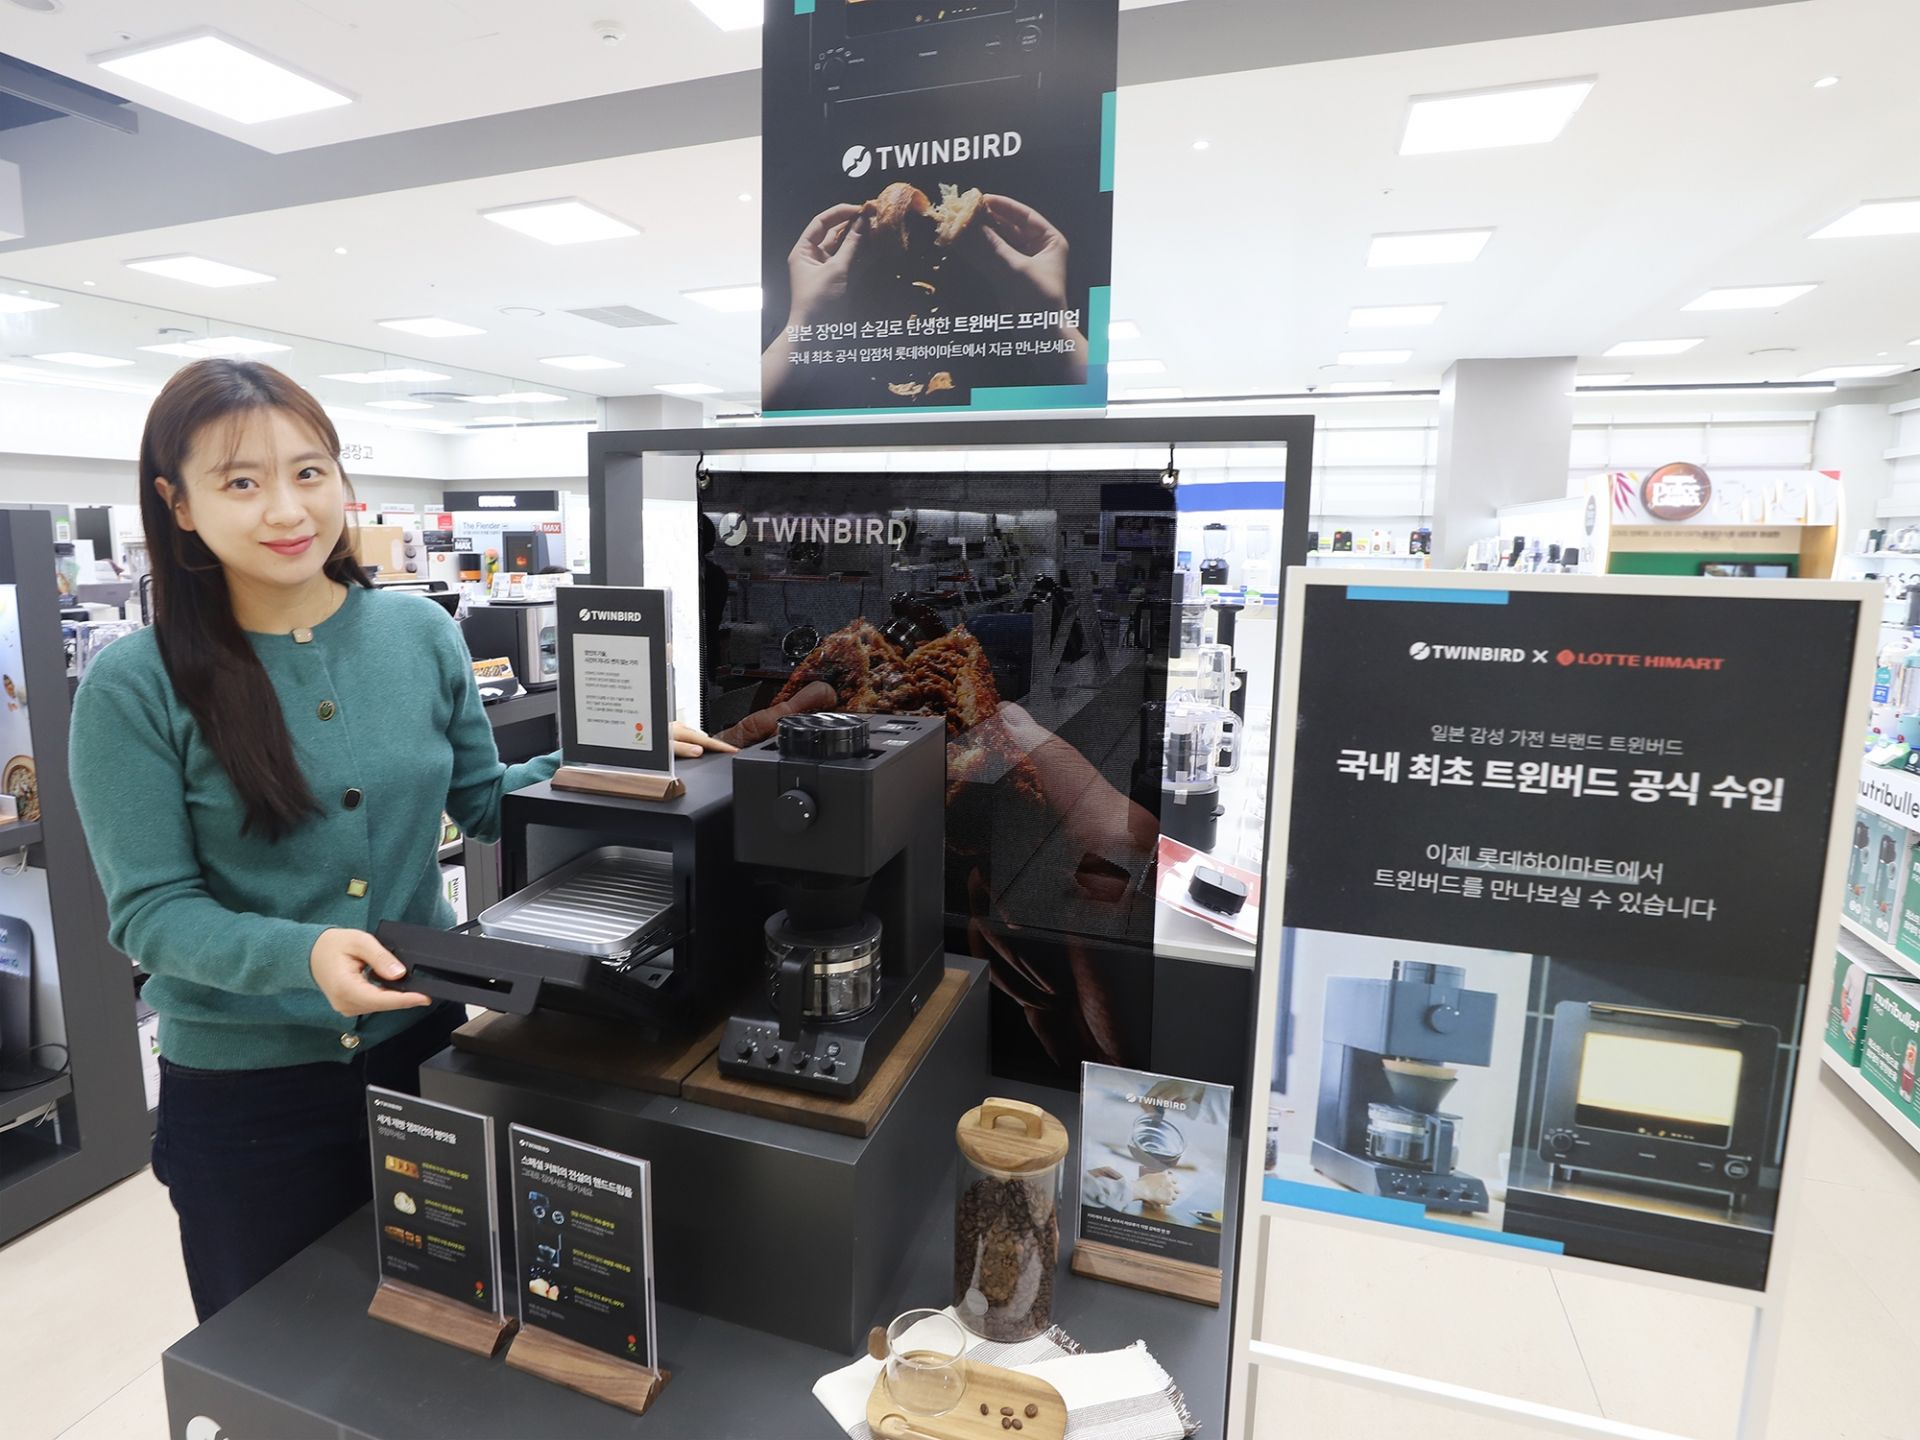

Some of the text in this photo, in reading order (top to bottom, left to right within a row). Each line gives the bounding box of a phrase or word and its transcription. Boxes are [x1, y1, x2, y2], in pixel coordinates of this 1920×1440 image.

[875, 131, 1023, 170] TWINBIRD
[787, 308, 1080, 342] 일본 장인의 손길로 탄생한 트윈버드 프리미엄
[788, 338, 1076, 366] 국내 최초 공식 입점처 롯데하이마트에서 지금 만나보세요
[752, 516, 907, 546] TWINBIRD
[590, 610, 642, 622] TWINBIRD
[1431, 643, 1526, 664] TWINBIRD
[1577, 652, 1640, 668] LOTTE
[1643, 655, 1725, 671] HIMART
[1430, 724, 1684, 756] 일본 감성 가전 브랜드 트윈버드
[1336, 747, 1785, 812] 국내 최초 트윈버드 공식 수입
[1425, 842, 1664, 885] 이제 롯데하이마트에서
[1373, 867, 1717, 922] 트윈버드를 만나보실 수 있습니다
[1874, 992, 1920, 1034] nutribullet
[1136, 1095, 1187, 1112] TWINBIRD
